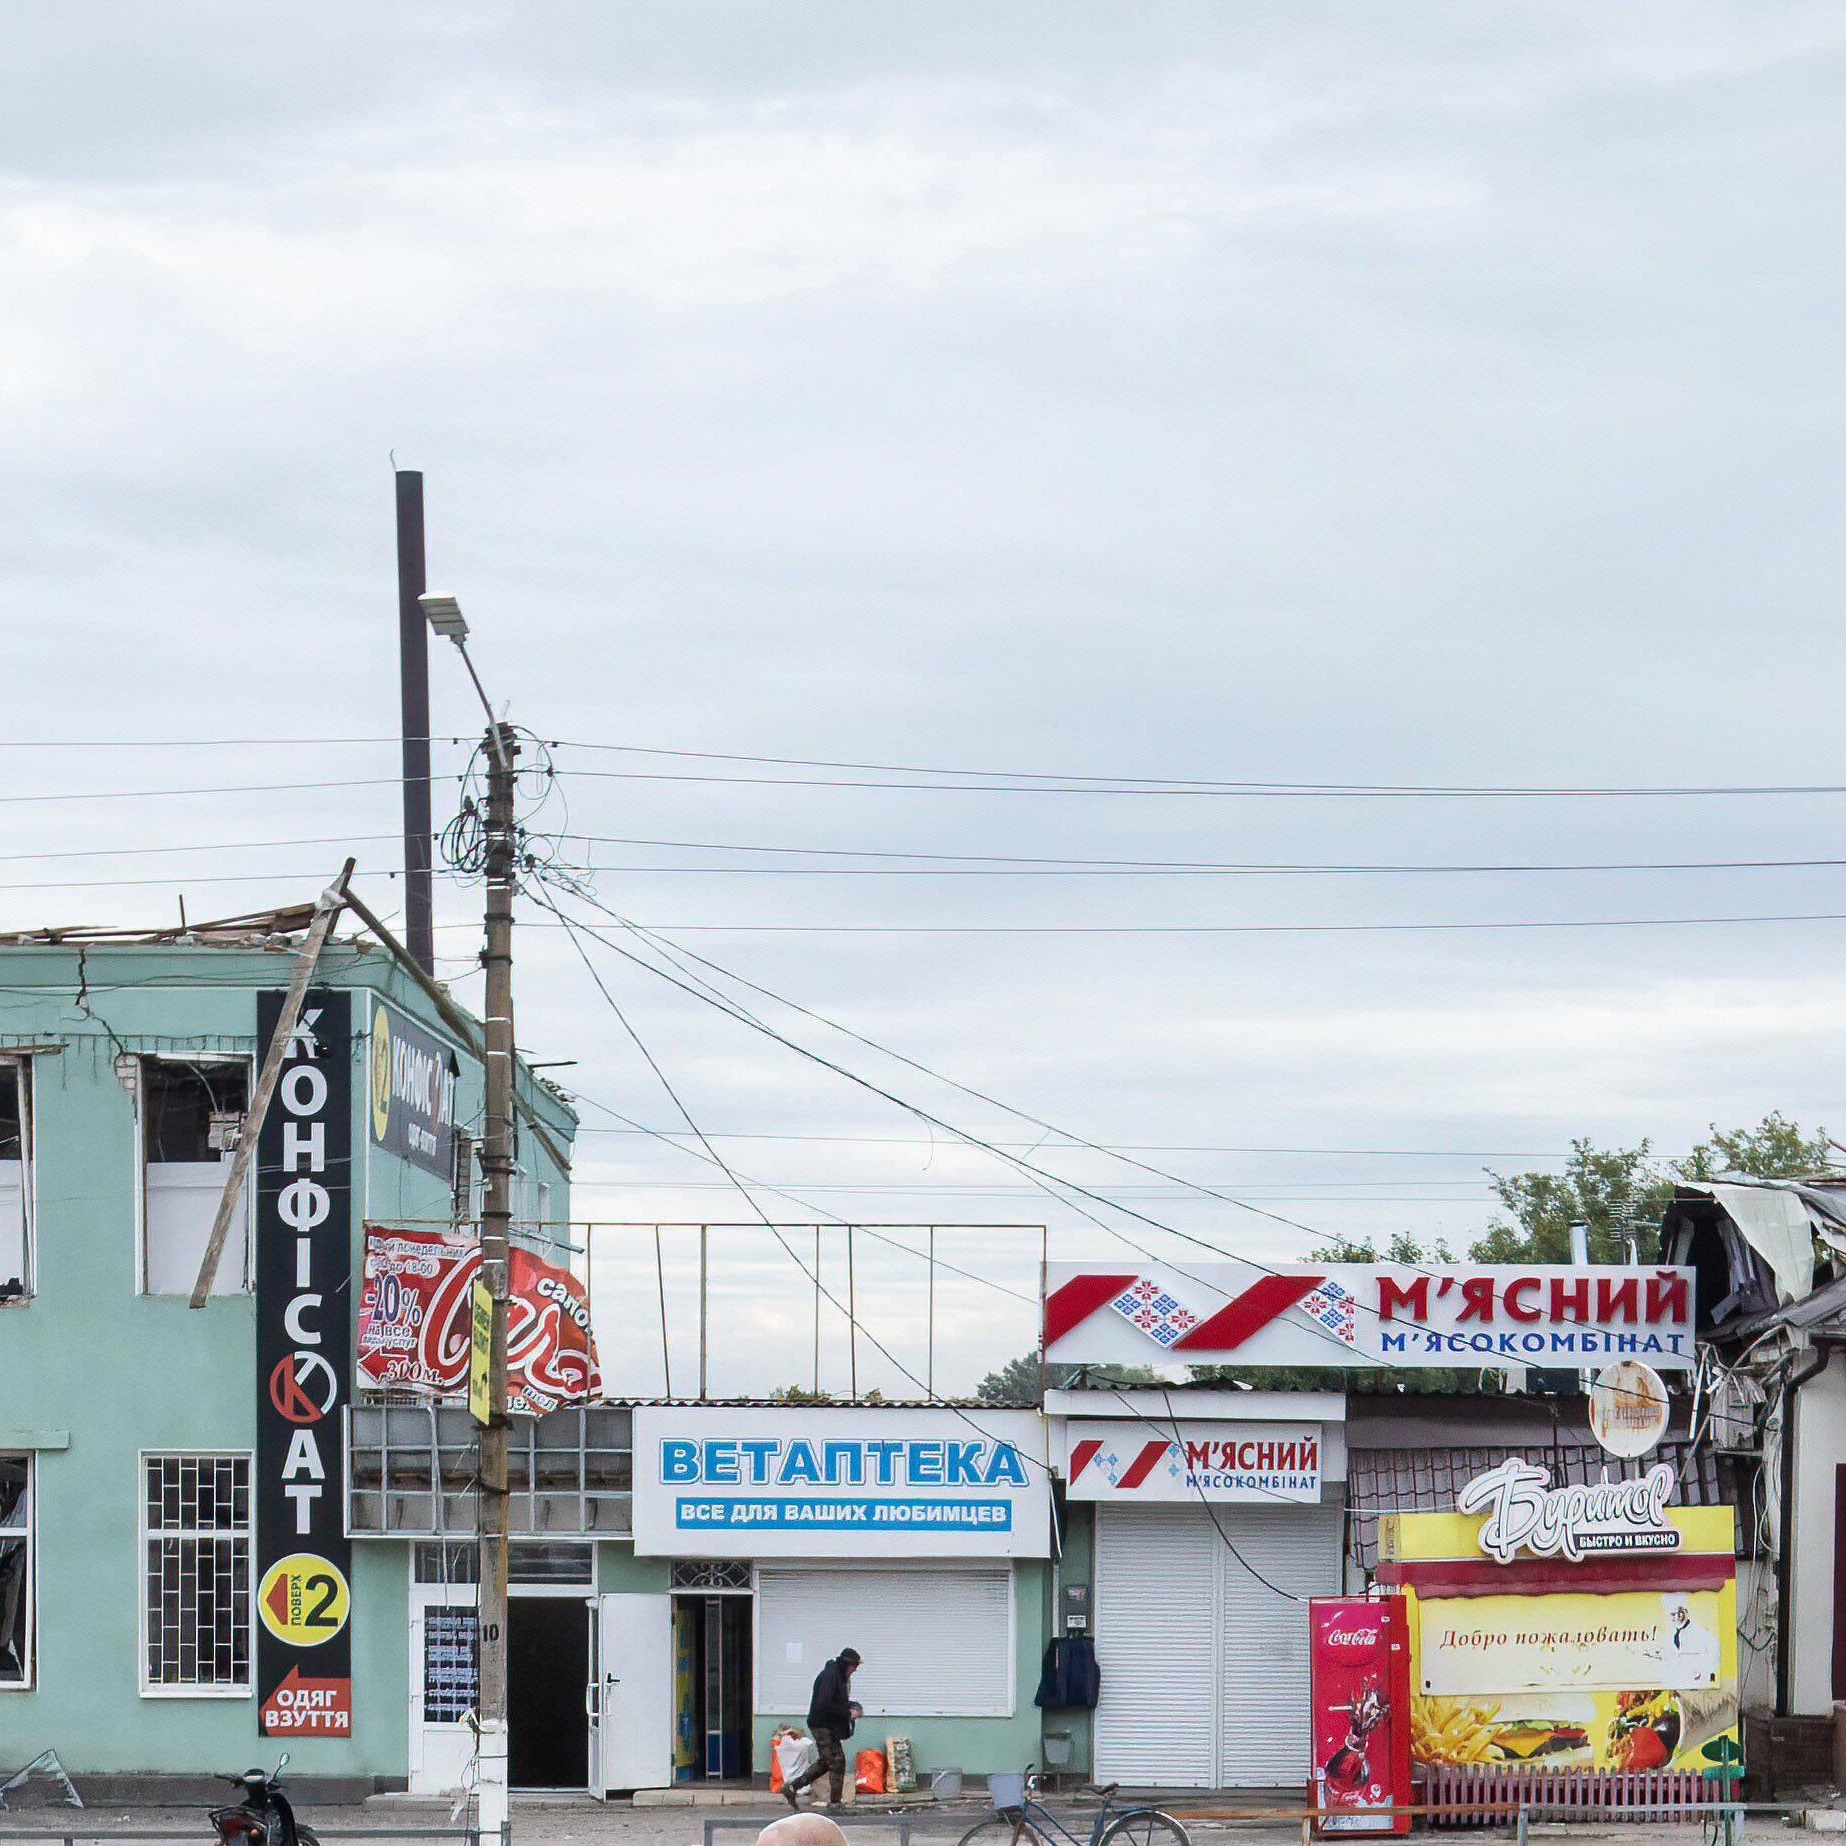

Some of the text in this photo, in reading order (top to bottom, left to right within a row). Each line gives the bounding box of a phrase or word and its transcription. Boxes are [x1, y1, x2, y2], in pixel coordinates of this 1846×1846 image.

[537, 1277, 593, 1336] сало
[1376, 1269, 1690, 1325] М'ЯСНИЙ
[1381, 1332, 1685, 1354] М'ЯСОКОМБІНАТ
[659, 1437, 1030, 1488] ВЕТАПТЕКА
[1186, 1435, 1319, 1472] М'ЯСНИЙ
[1186, 1475, 1317, 1490] М'ЯСОКОМБІНАТ
[680, 1503, 1007, 1525] ВСЕ ДЛЯ ВАШИХ ЛЮБИМЦЕВ
[1579, 1533, 1676, 1548] БЫСТРО И ВКУСНО
[290, 1573, 302, 1627] ПОВЕРХ
[304, 1573, 339, 1627] 2
[482, 1624, 500, 1642] 10
[1439, 1625, 1659, 1651] Добро пожаловать!
[276, 1689, 338, 1710] ОДЯГ
[265, 1710, 349, 1728] ВЗУТТЯ
